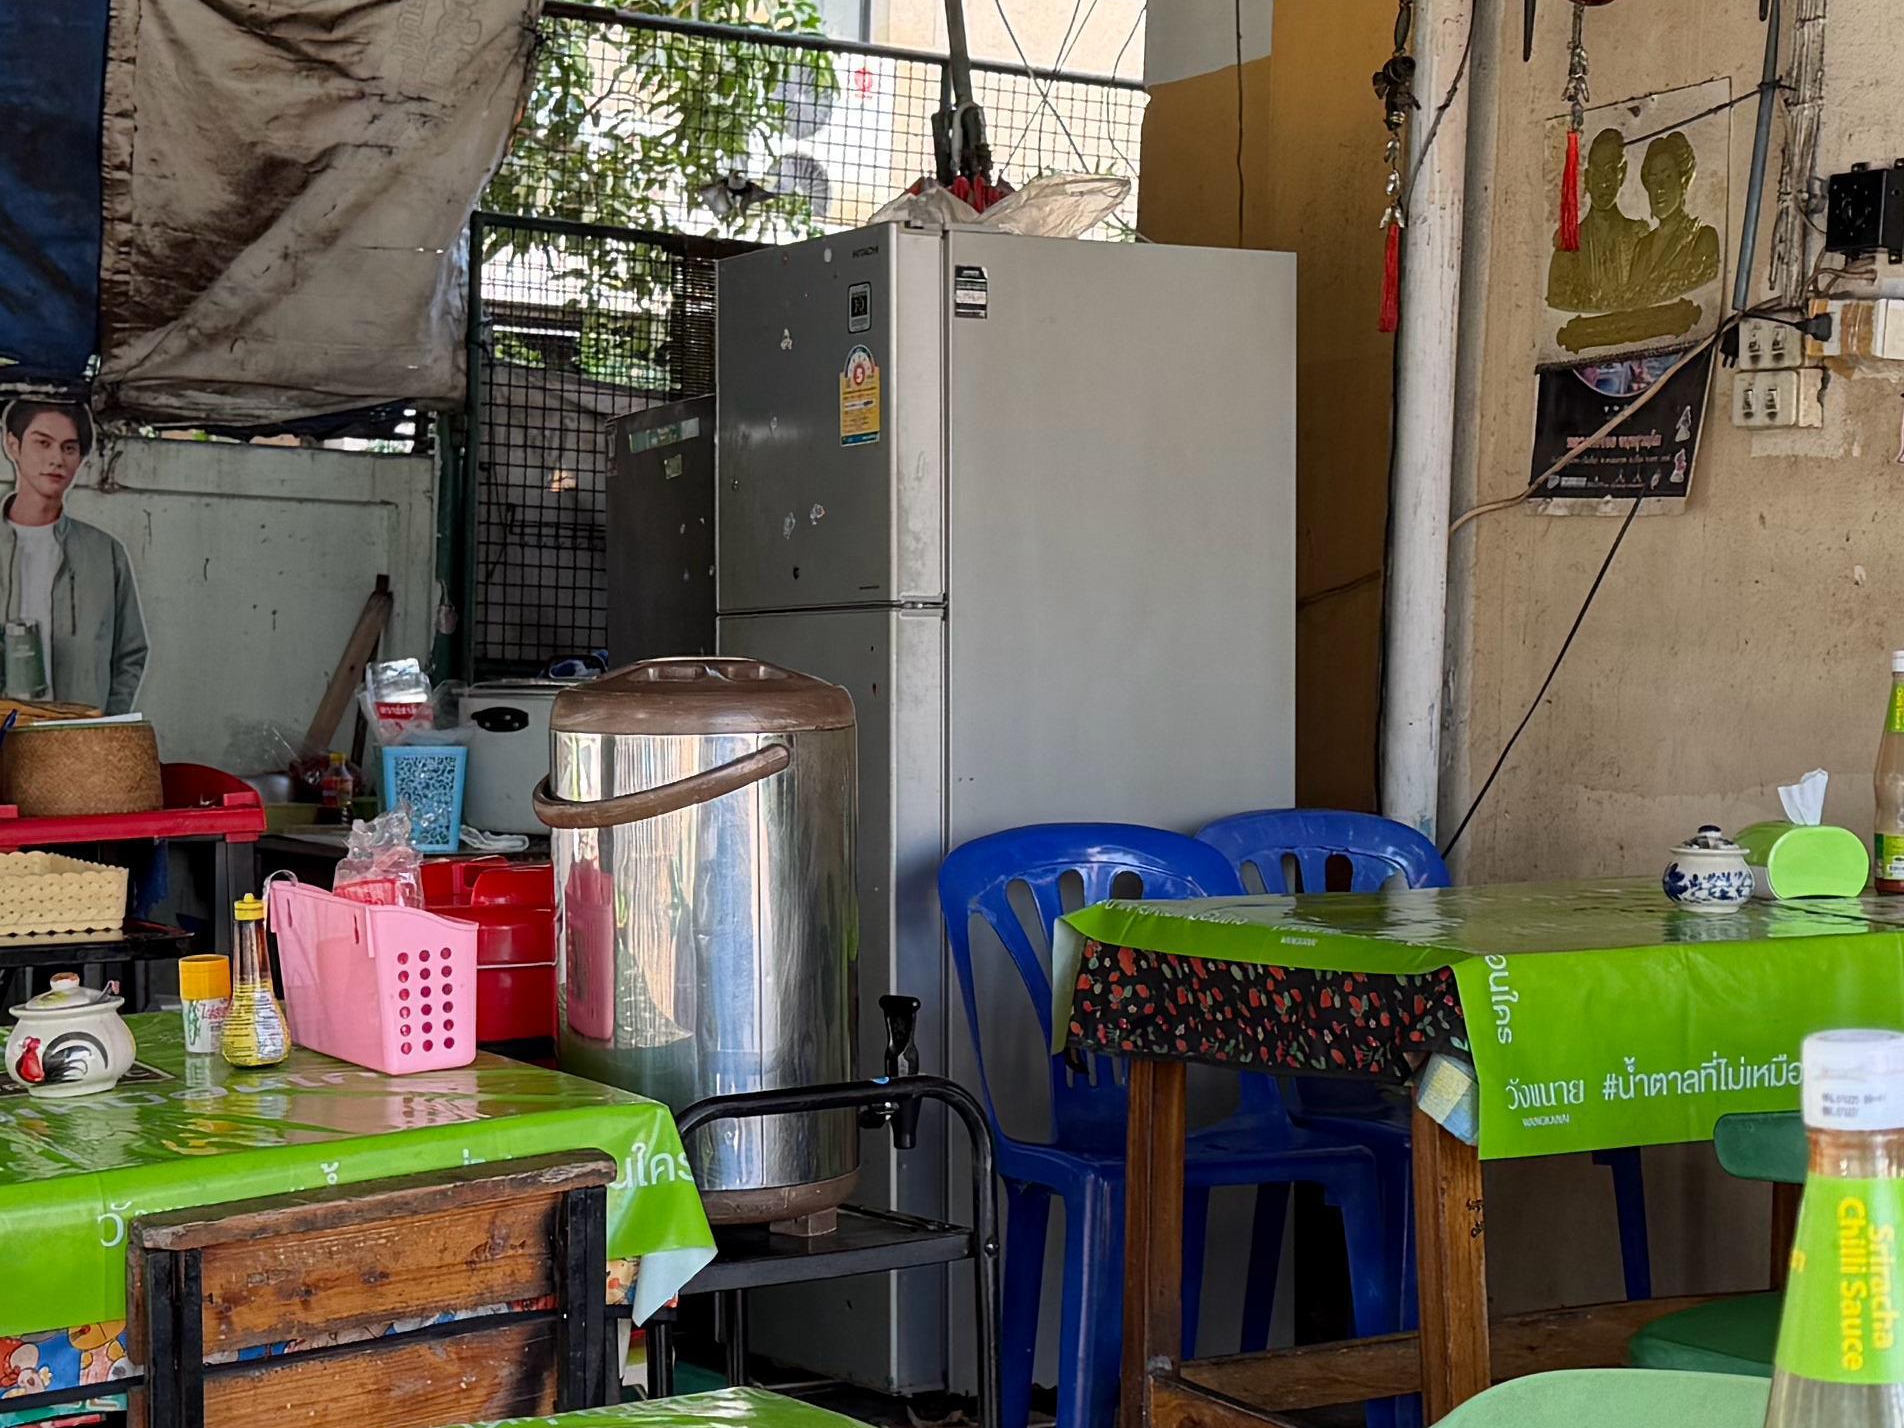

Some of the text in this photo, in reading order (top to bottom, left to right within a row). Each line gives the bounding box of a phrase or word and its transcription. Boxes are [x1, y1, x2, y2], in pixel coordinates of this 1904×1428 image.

[1837, 1196, 1869, 1373] Chilli Sauce
[1867, 1223, 1900, 1351] Sriracha
